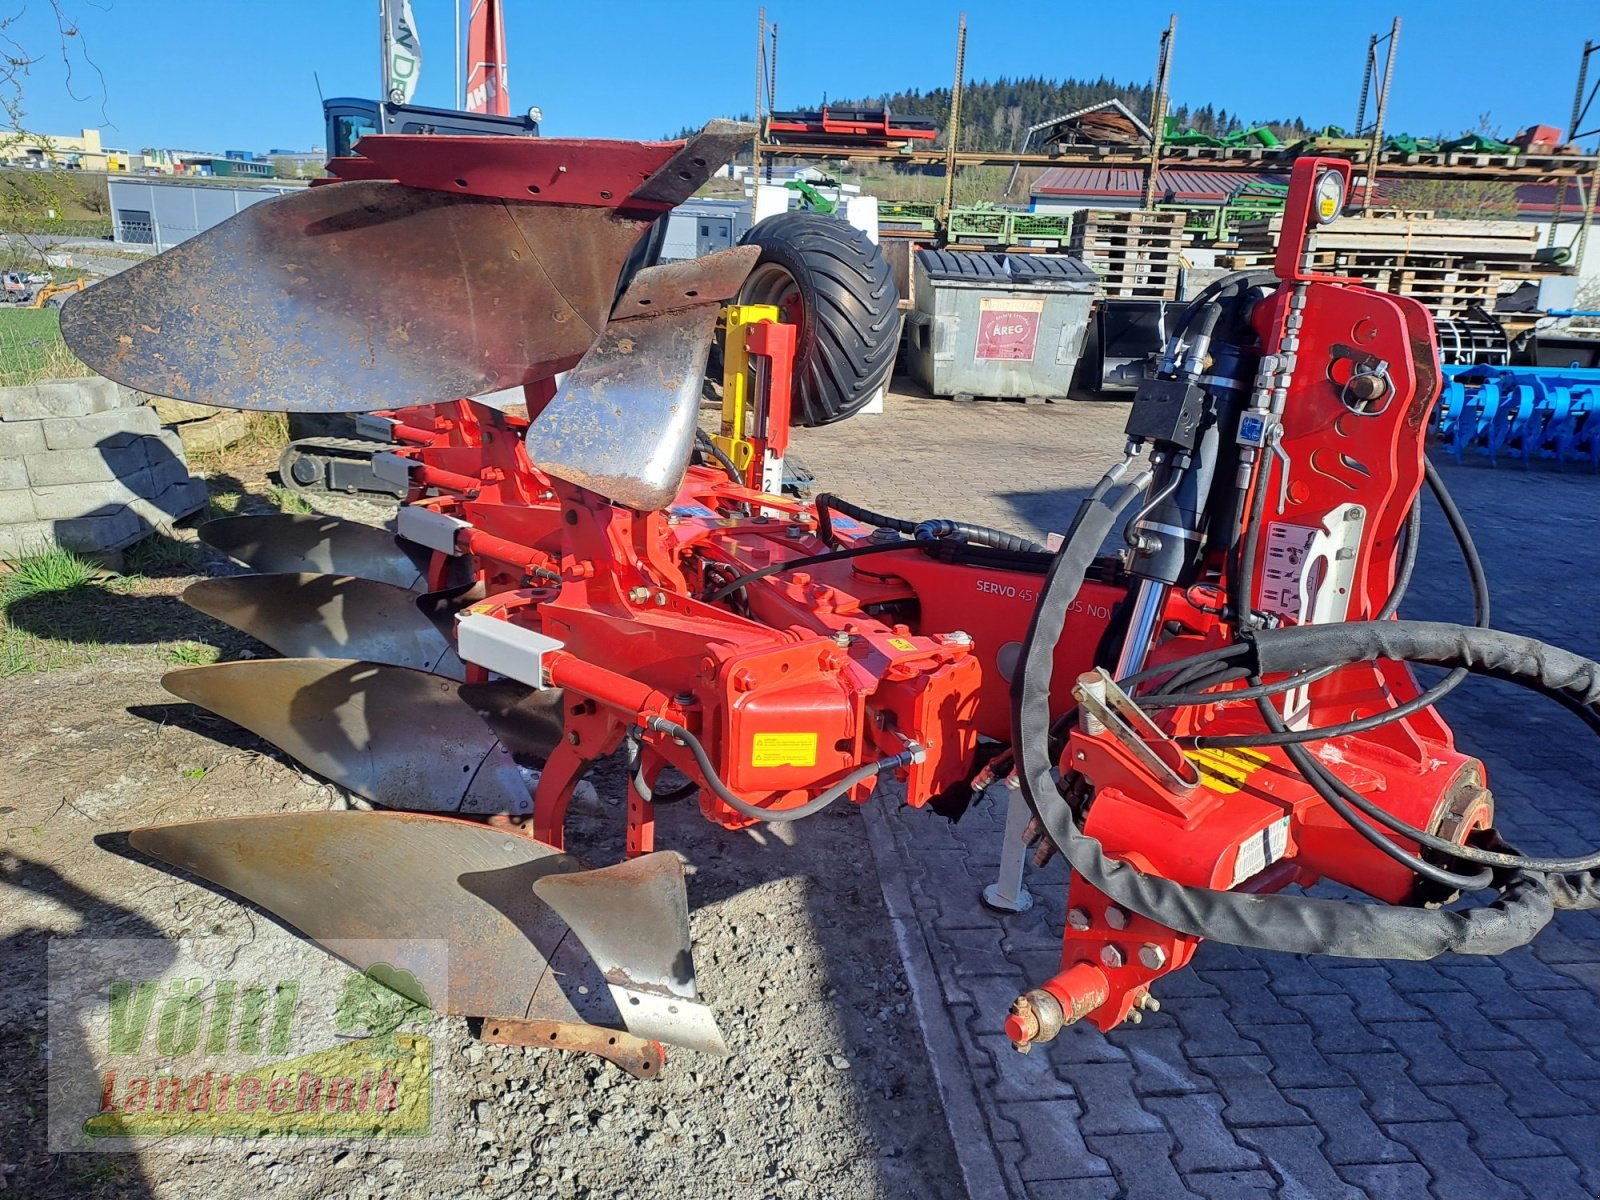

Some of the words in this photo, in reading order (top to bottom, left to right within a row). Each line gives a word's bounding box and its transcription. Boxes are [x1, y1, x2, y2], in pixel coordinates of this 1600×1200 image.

[765, 479, 771, 492] 2
[976, 580, 1016, 598] SERVO
[1018, 589, 1033, 601] 45
